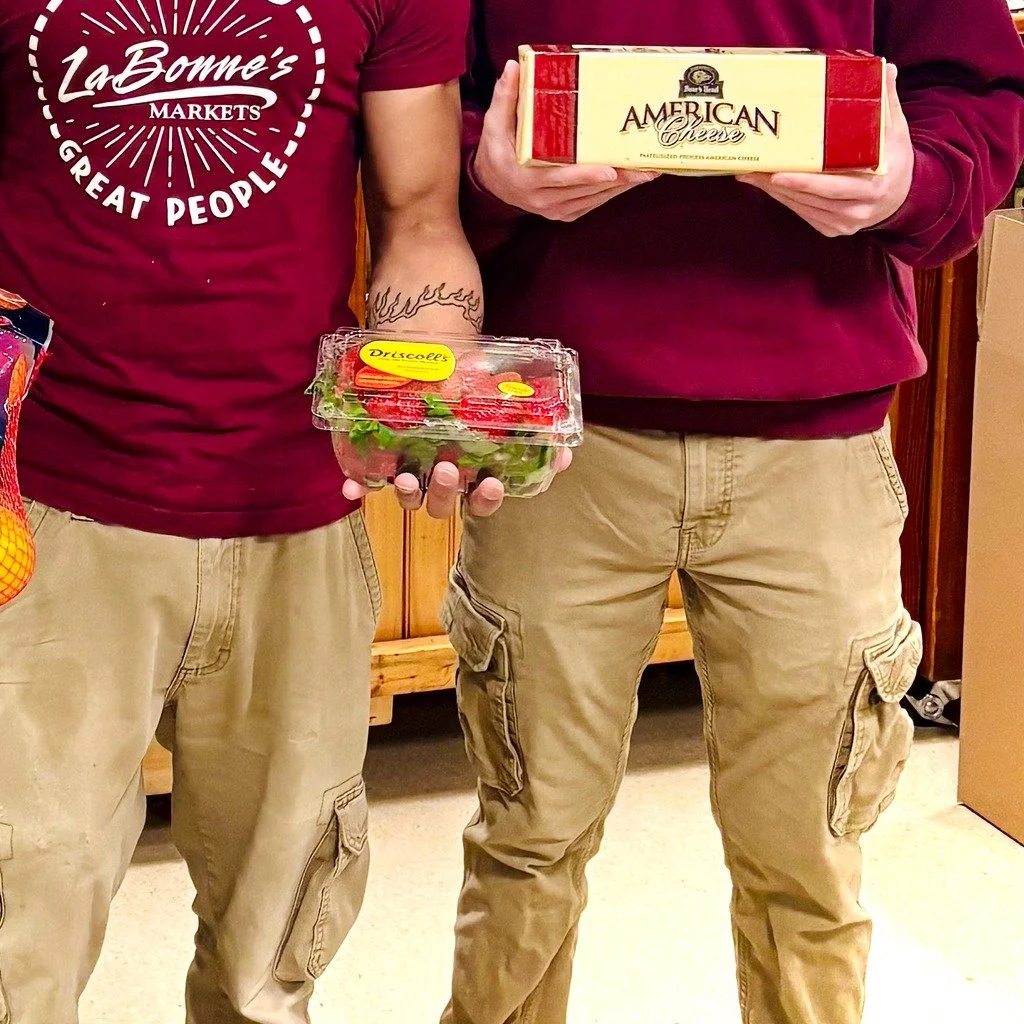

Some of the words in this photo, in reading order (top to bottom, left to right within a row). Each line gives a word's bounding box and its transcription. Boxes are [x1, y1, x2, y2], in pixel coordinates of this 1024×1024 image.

[57, 39, 299, 103] LaBonne's
[148, 103, 261, 121] MARKETS
[619, 100, 781, 138] AMERICAN
[656, 114, 746, 148] Cheese
[58, 139, 151, 220] GREAT
[166, 152, 288, 226] PEOPLE
[369, 348, 449, 363] Driscoll's
